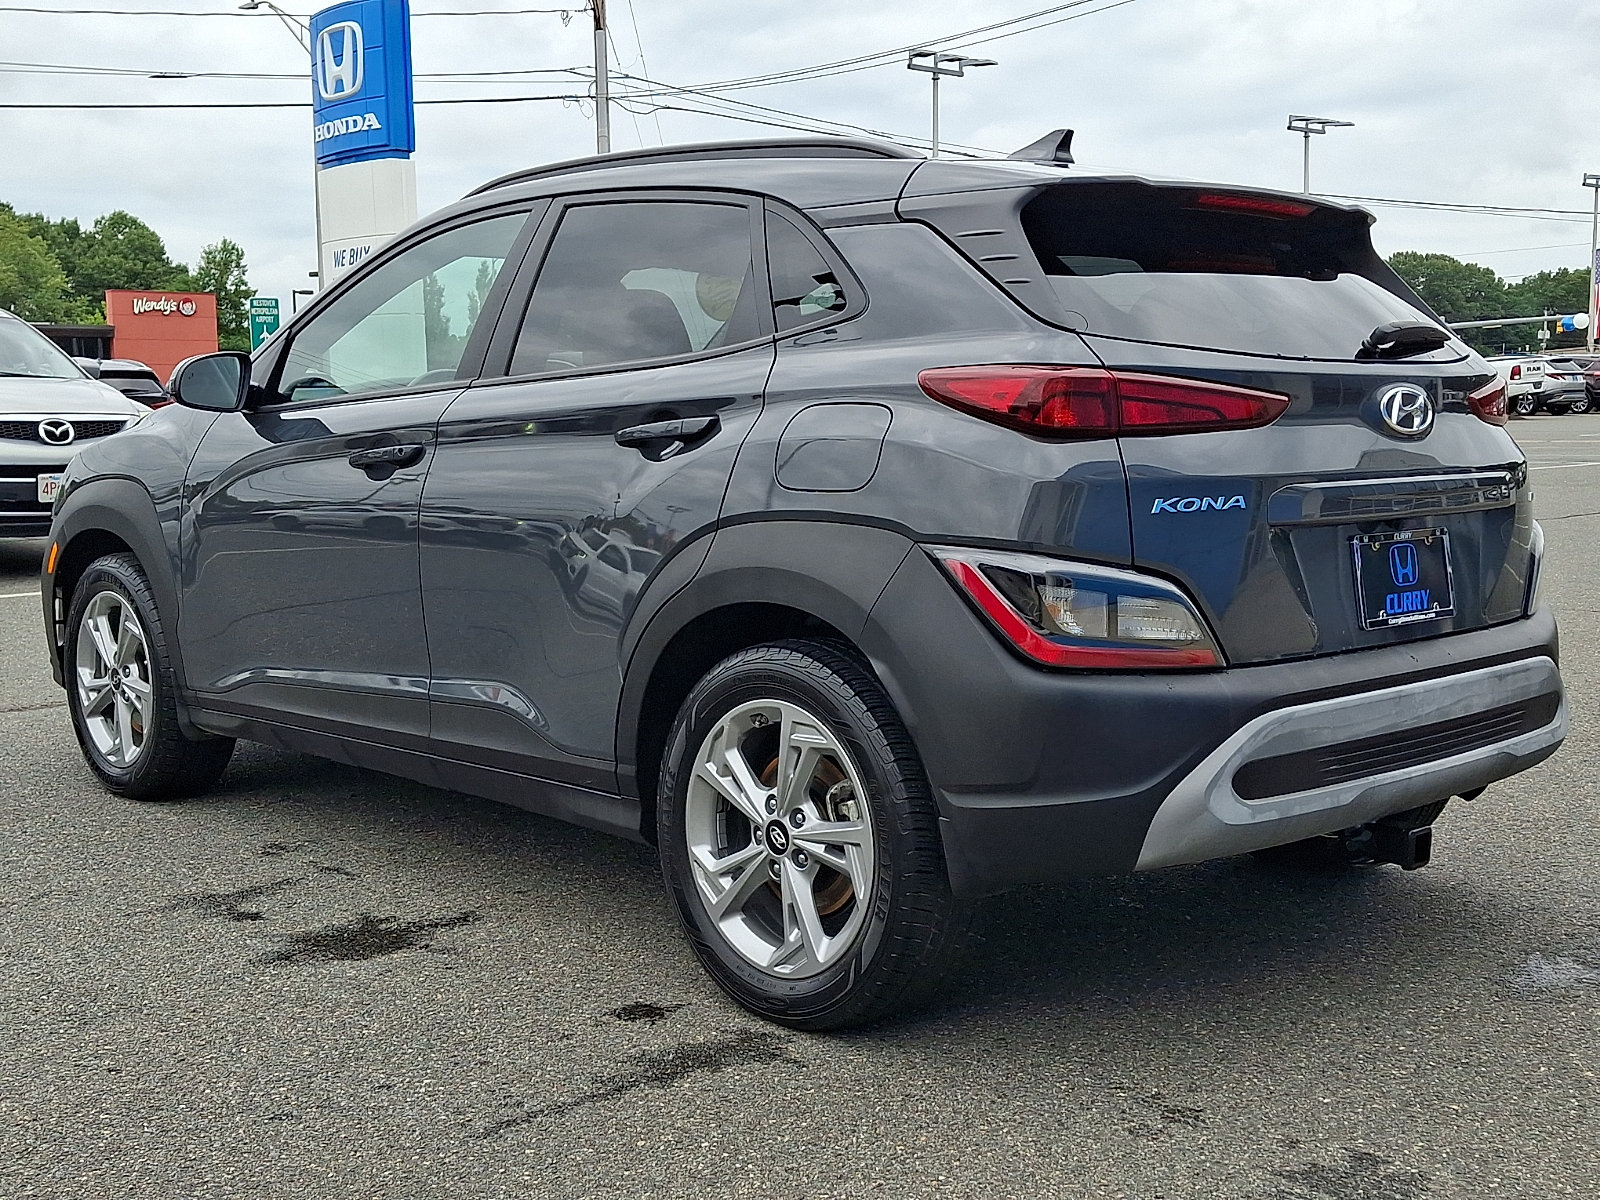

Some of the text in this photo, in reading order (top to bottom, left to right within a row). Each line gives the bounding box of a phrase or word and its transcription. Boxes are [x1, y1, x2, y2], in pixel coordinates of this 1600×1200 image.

[315, 113, 381, 142] HONDA
[333, 245, 370, 269] WE BUY
[133, 295, 177, 315] Wendy's
[42, 481, 58, 495] 4P
[1151, 495, 1246, 514] KONA
[1394, 532, 1412, 541] CURRY
[1386, 589, 1429, 614] CURRY
